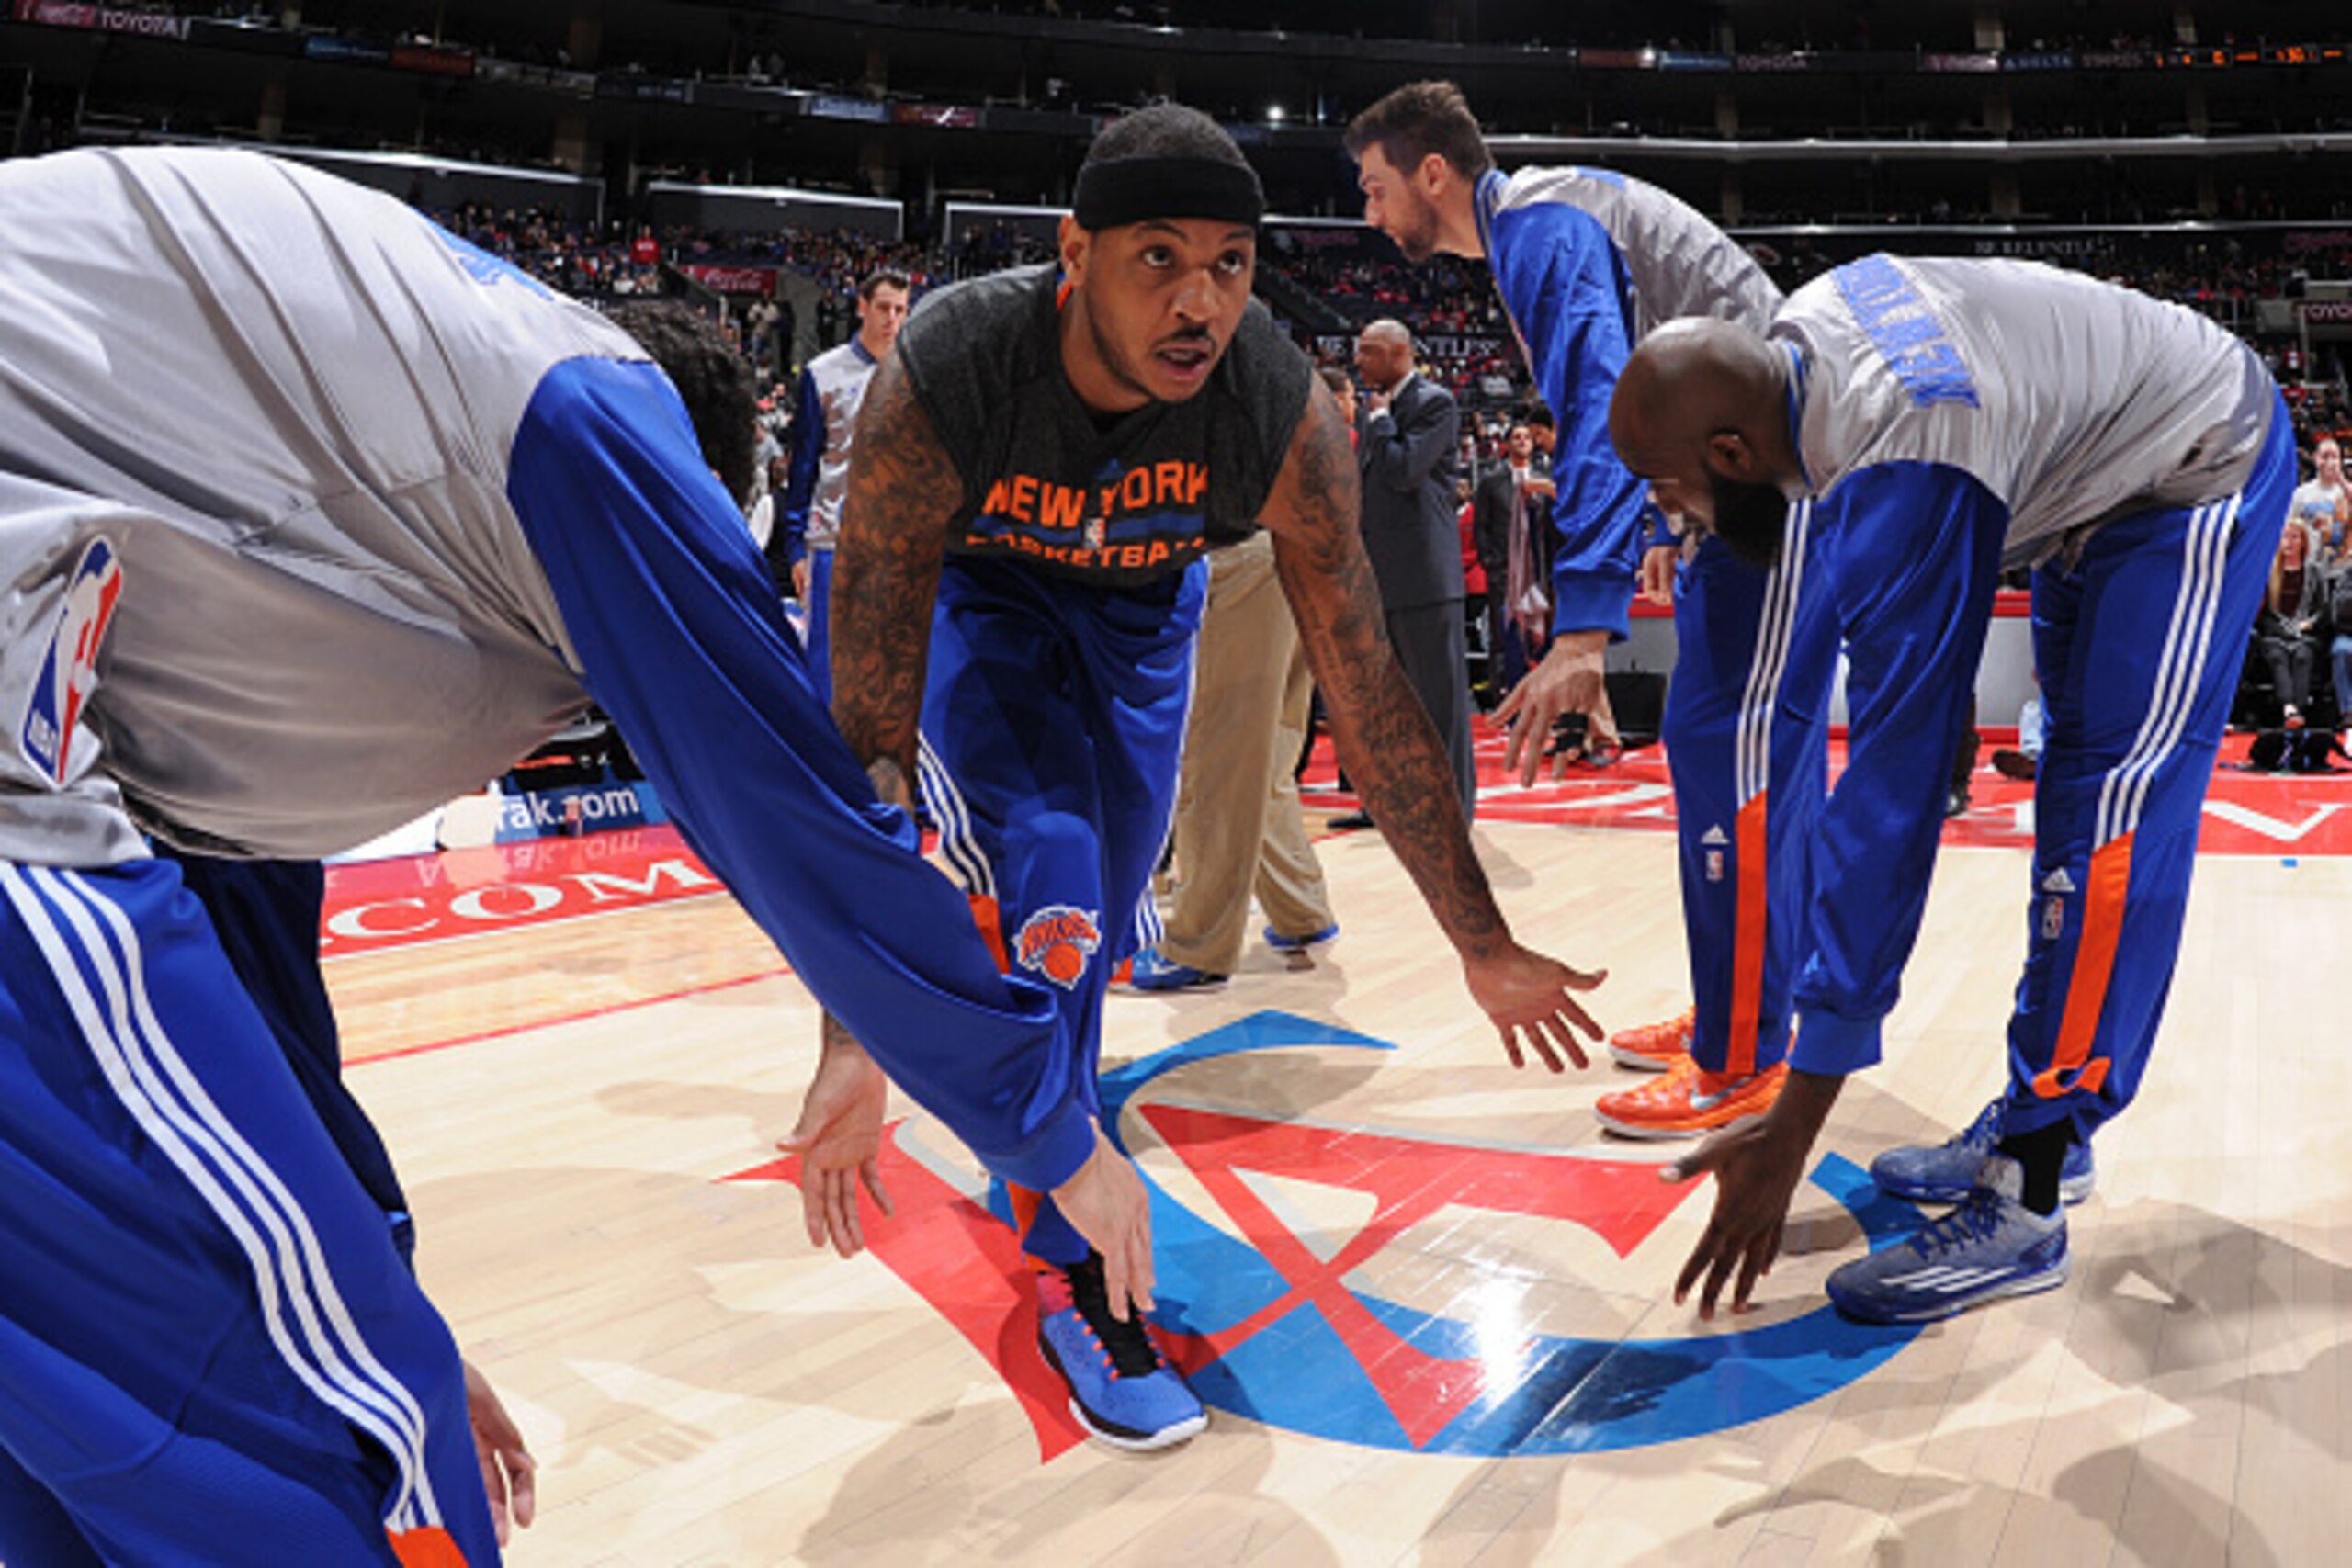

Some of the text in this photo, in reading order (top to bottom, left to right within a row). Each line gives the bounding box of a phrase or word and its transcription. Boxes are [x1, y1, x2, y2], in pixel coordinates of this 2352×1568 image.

[101, 10, 179, 37] TOYOTA
[982, 459, 1209, 528] NEW YORK
